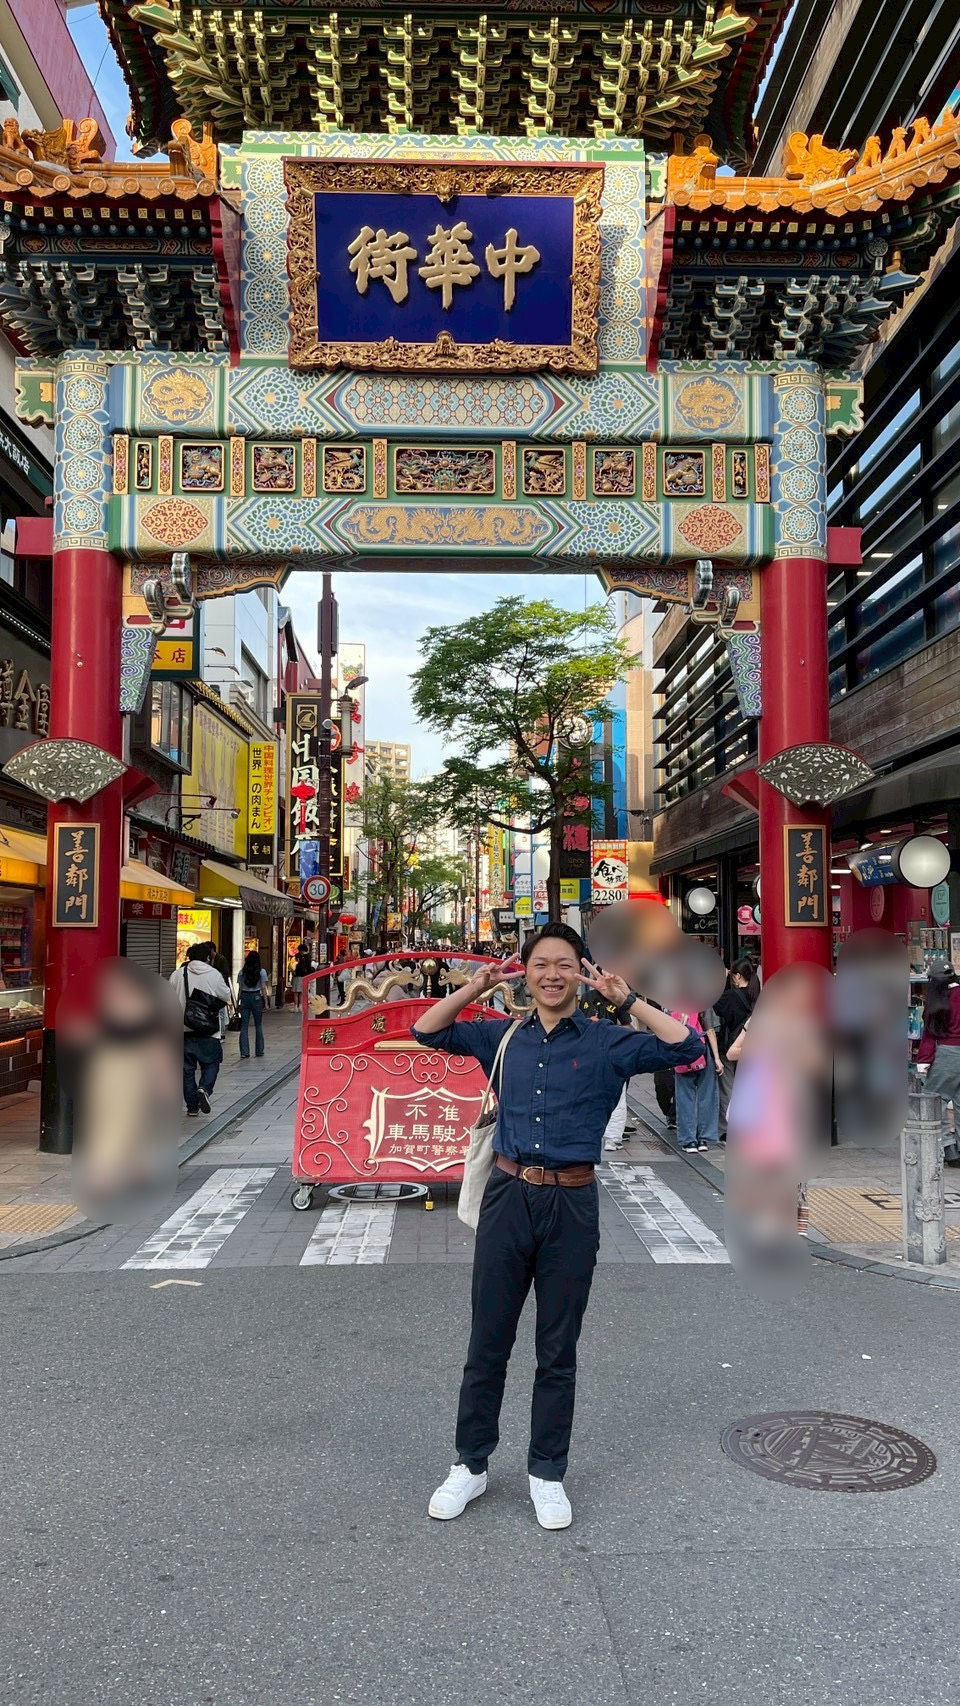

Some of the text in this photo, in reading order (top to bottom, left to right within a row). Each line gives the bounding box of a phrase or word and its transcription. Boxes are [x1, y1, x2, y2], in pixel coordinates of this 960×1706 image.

[347, 221, 540, 311] 中華街
[251, 747, 262, 829] 世界一の肉まん
[309, 883, 326, 896] 30
[594, 890, 622, 901] 2280
[405, 1104, 460, 1121] 不准
